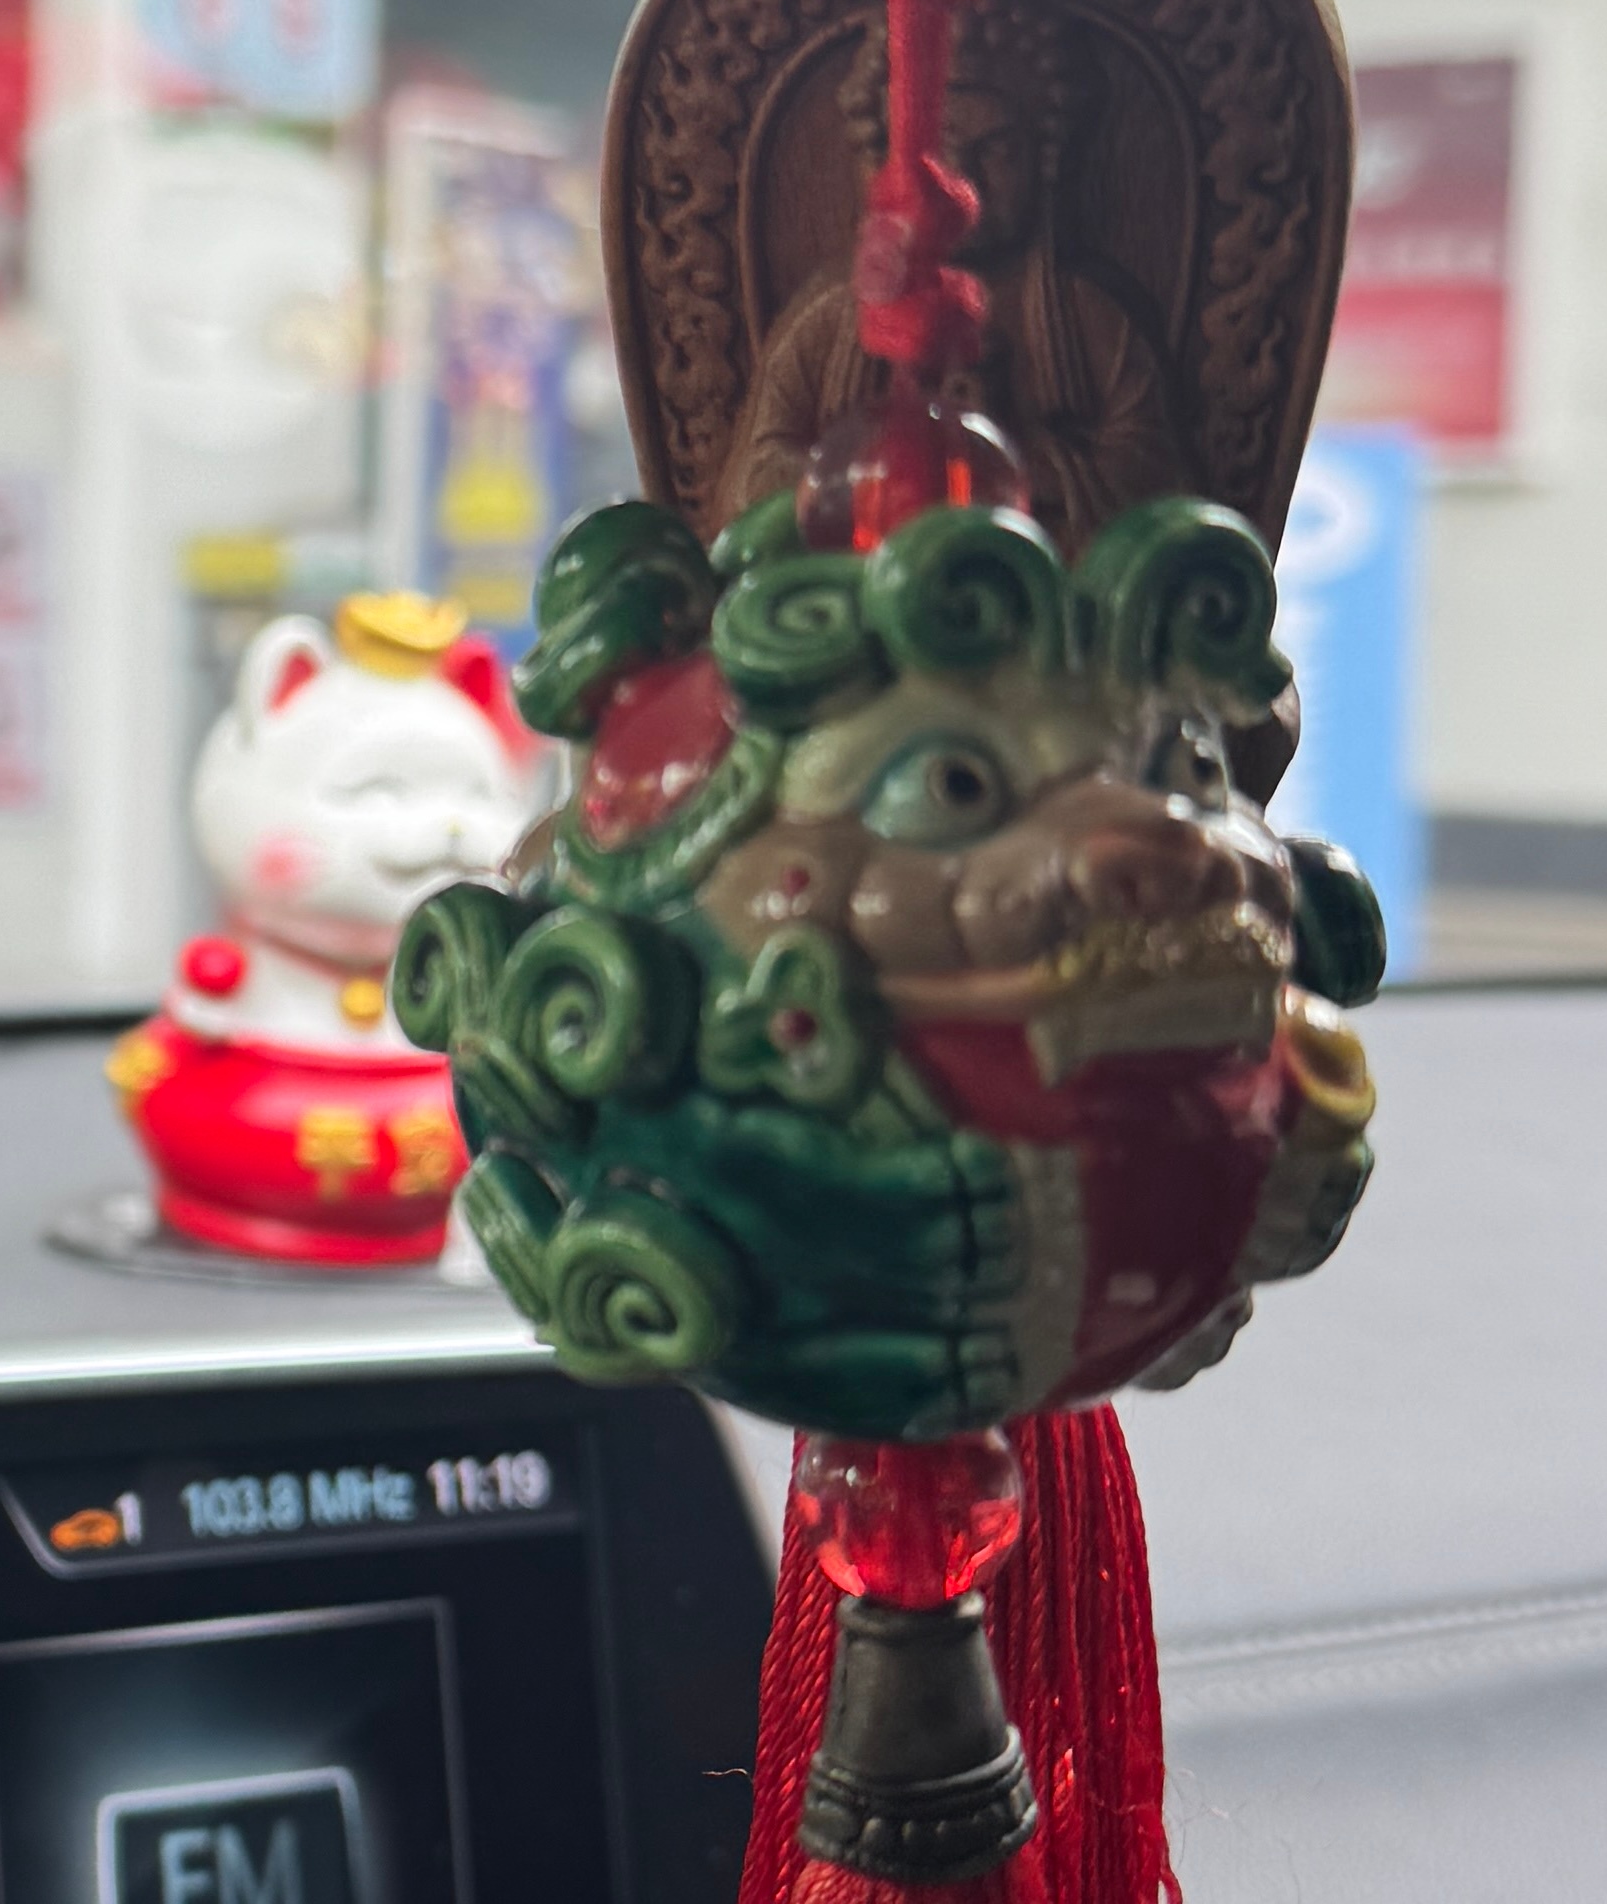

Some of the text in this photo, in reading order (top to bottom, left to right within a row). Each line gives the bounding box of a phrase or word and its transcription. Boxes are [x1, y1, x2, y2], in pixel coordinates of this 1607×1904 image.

[181, 1461, 419, 1538] 103.8 MHz
[427, 1449, 552, 1516] 11:19
